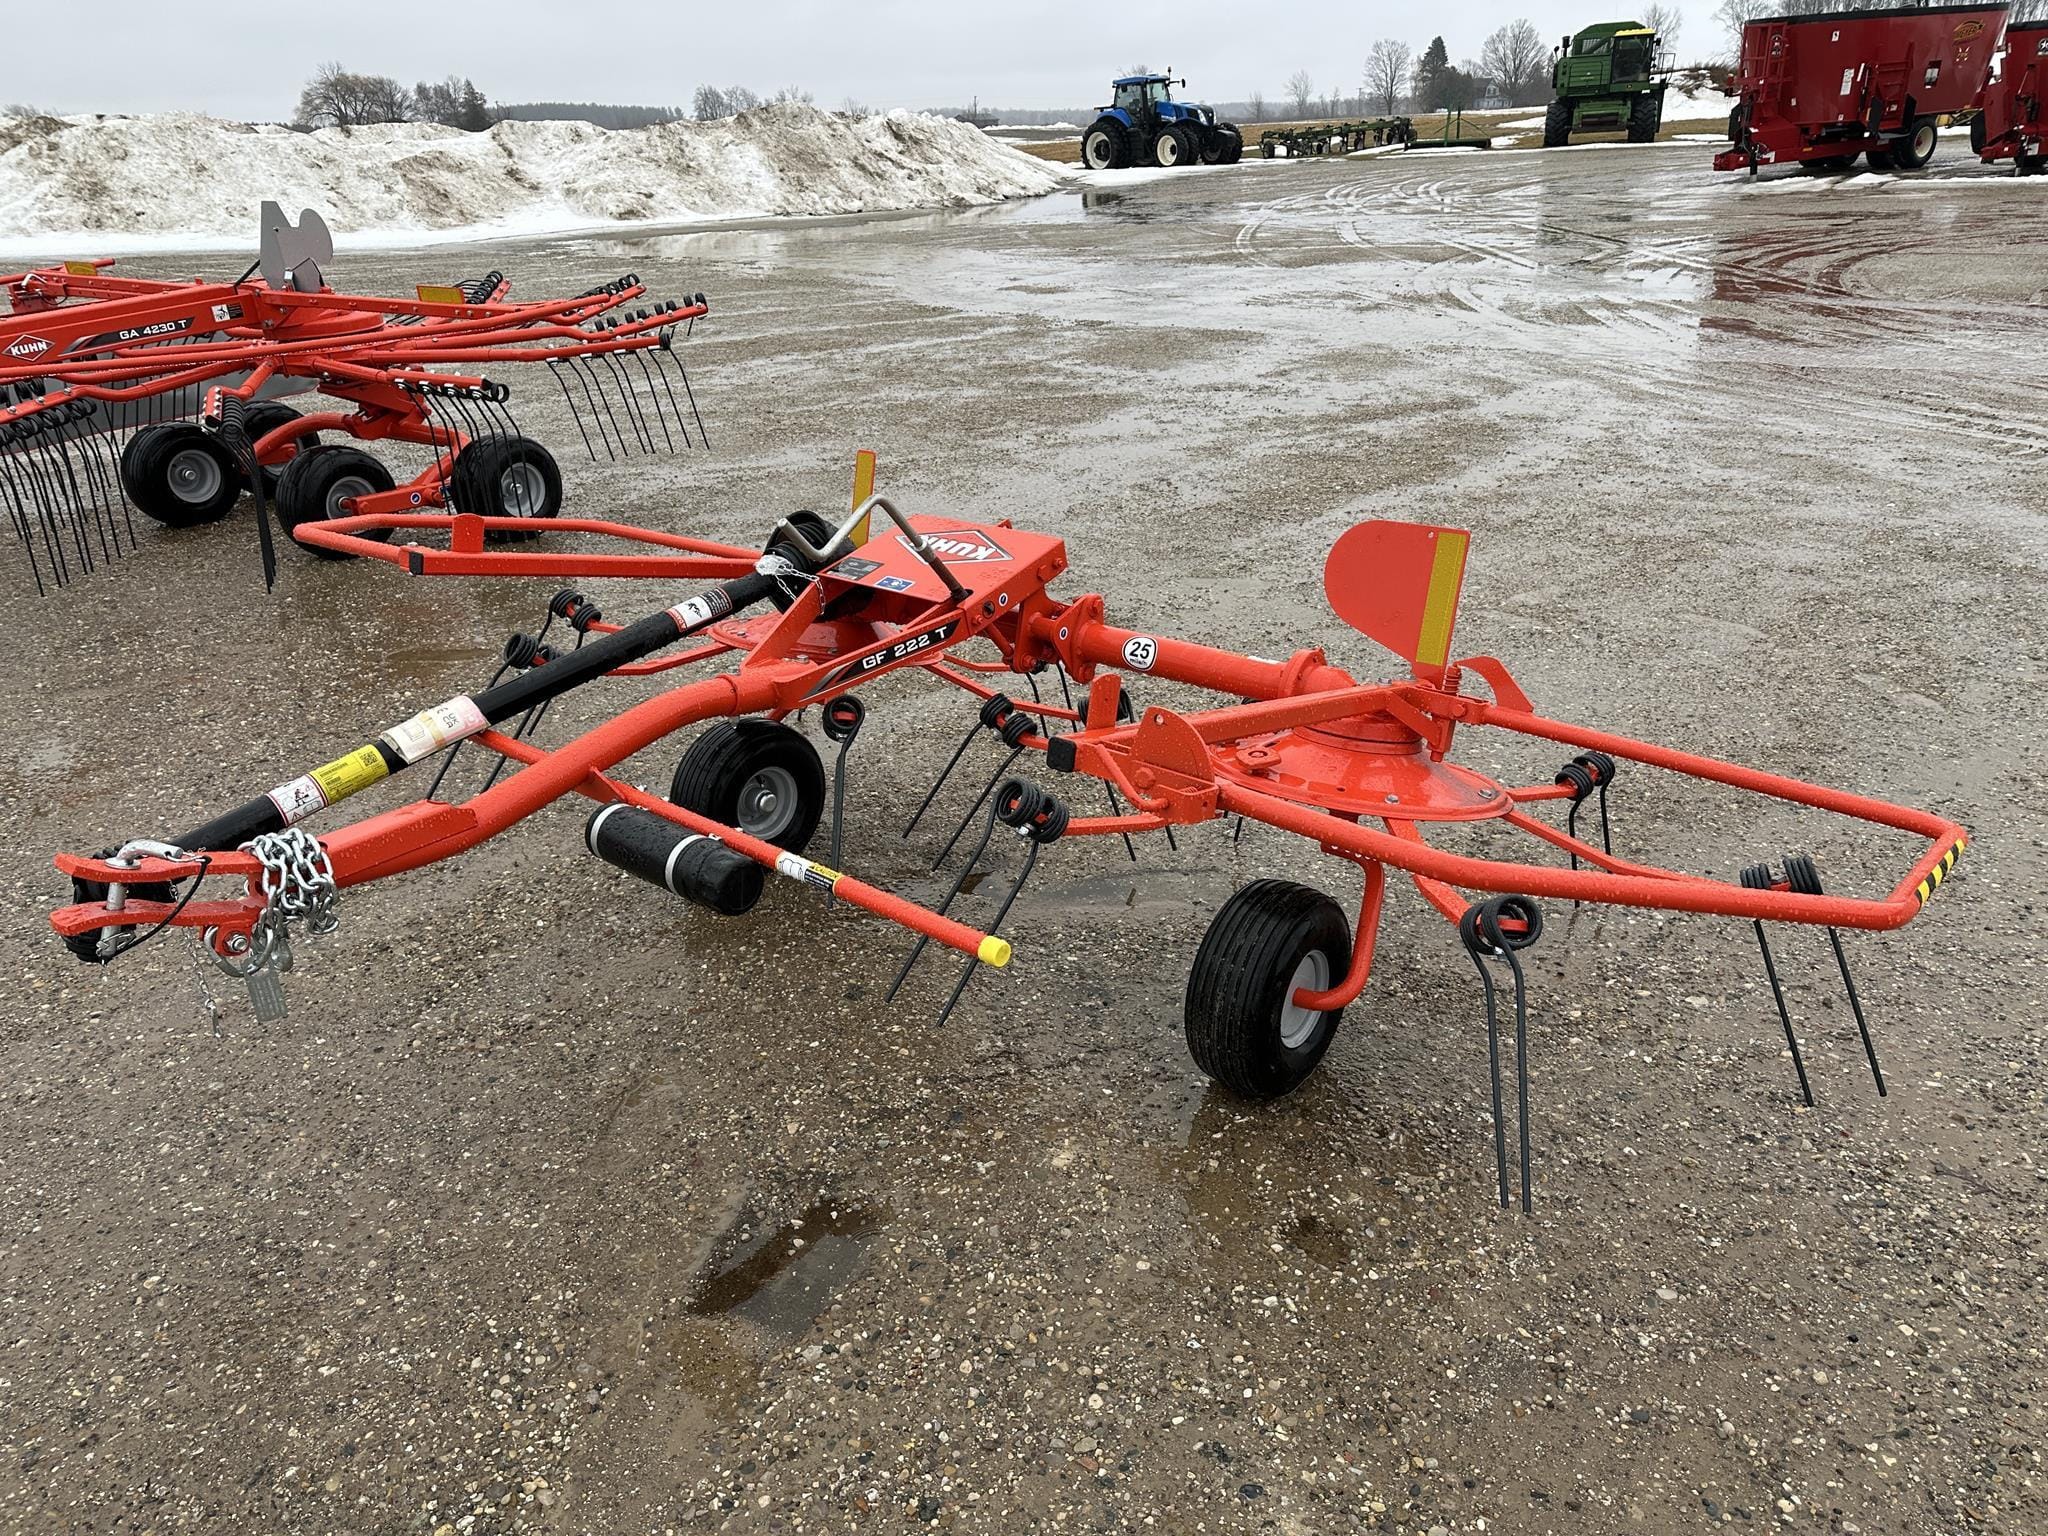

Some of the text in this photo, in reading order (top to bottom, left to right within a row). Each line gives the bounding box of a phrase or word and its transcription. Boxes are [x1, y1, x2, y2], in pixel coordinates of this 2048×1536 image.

[119, 320, 187, 340] GA 4230 T
[10, 341, 48, 356] KUHN
[862, 626, 947, 670] GF 222 T
[1129, 641, 1152, 659] 25
